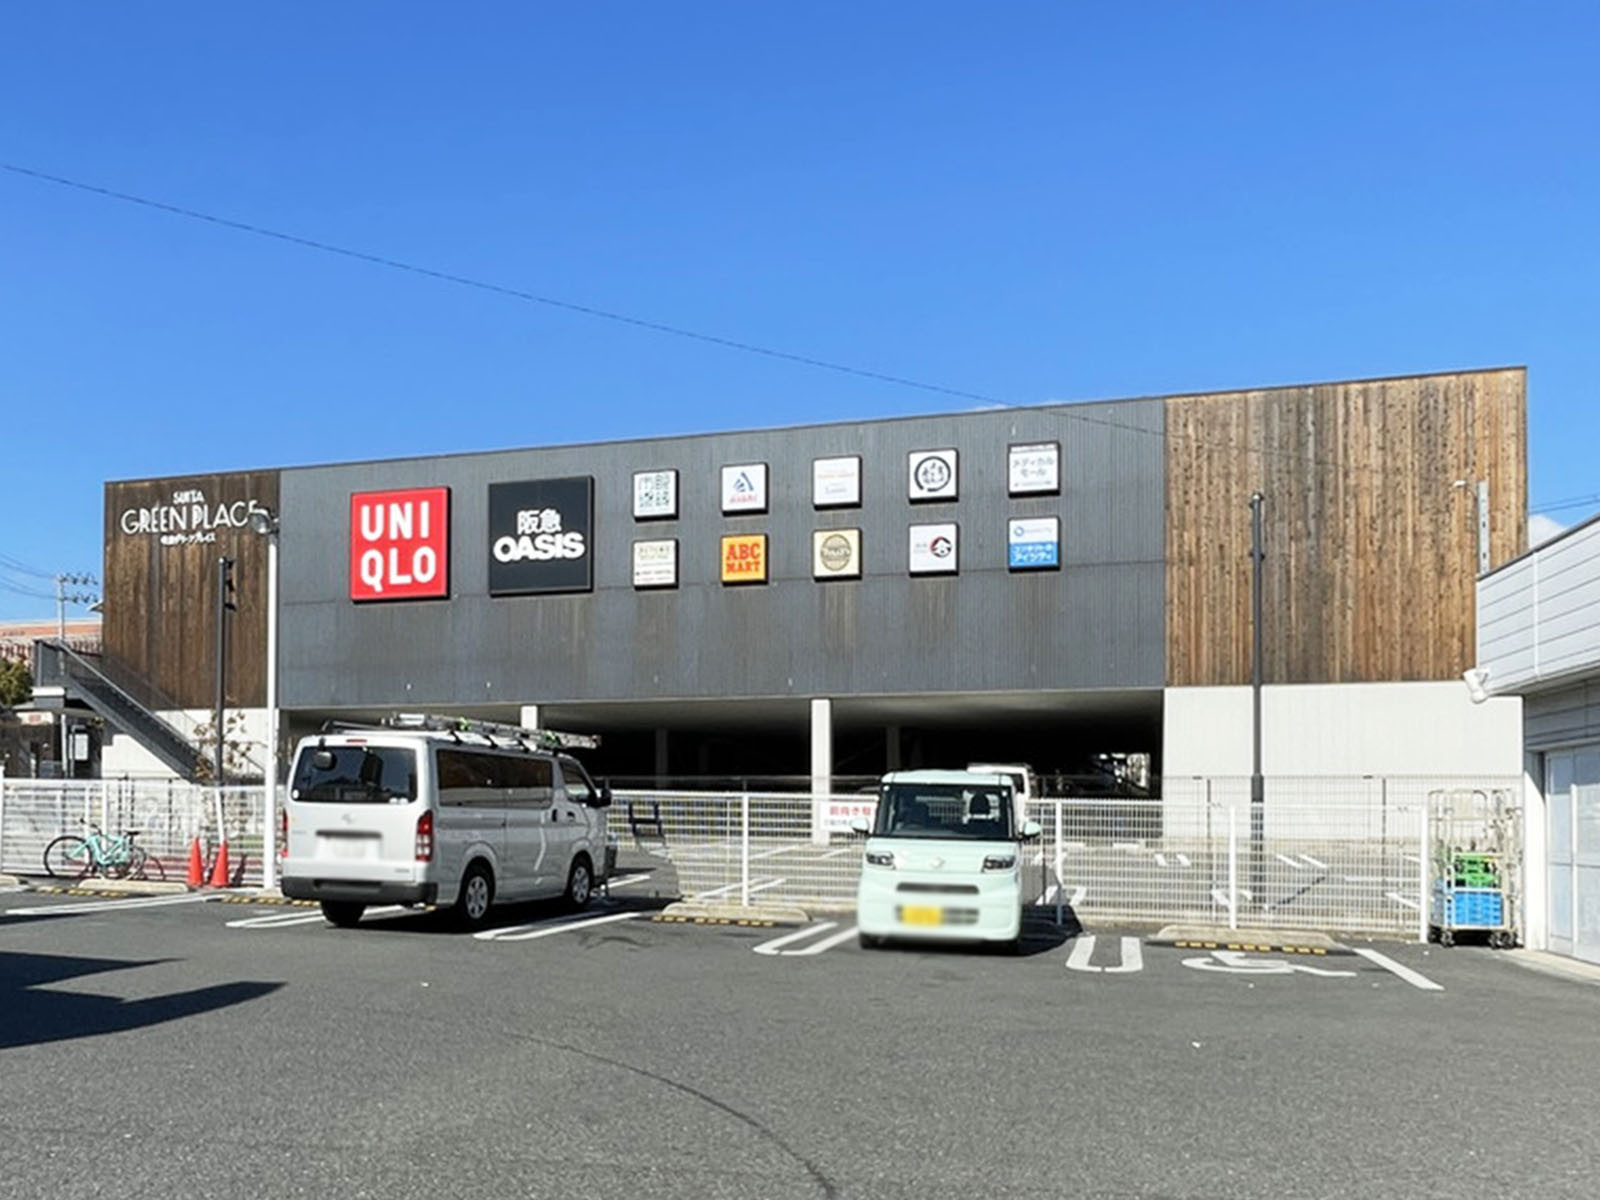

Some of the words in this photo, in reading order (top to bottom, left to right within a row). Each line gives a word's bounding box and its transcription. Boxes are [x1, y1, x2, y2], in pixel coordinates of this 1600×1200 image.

[121, 506, 187, 534] GREEN
[361, 501, 430, 541] UNI
[517, 508, 562, 534] 阪急
[493, 532, 585, 563] OASIS
[726, 542, 761, 562] ABC
[360, 546, 437, 592] QLO
[726, 560, 761, 574] MART
